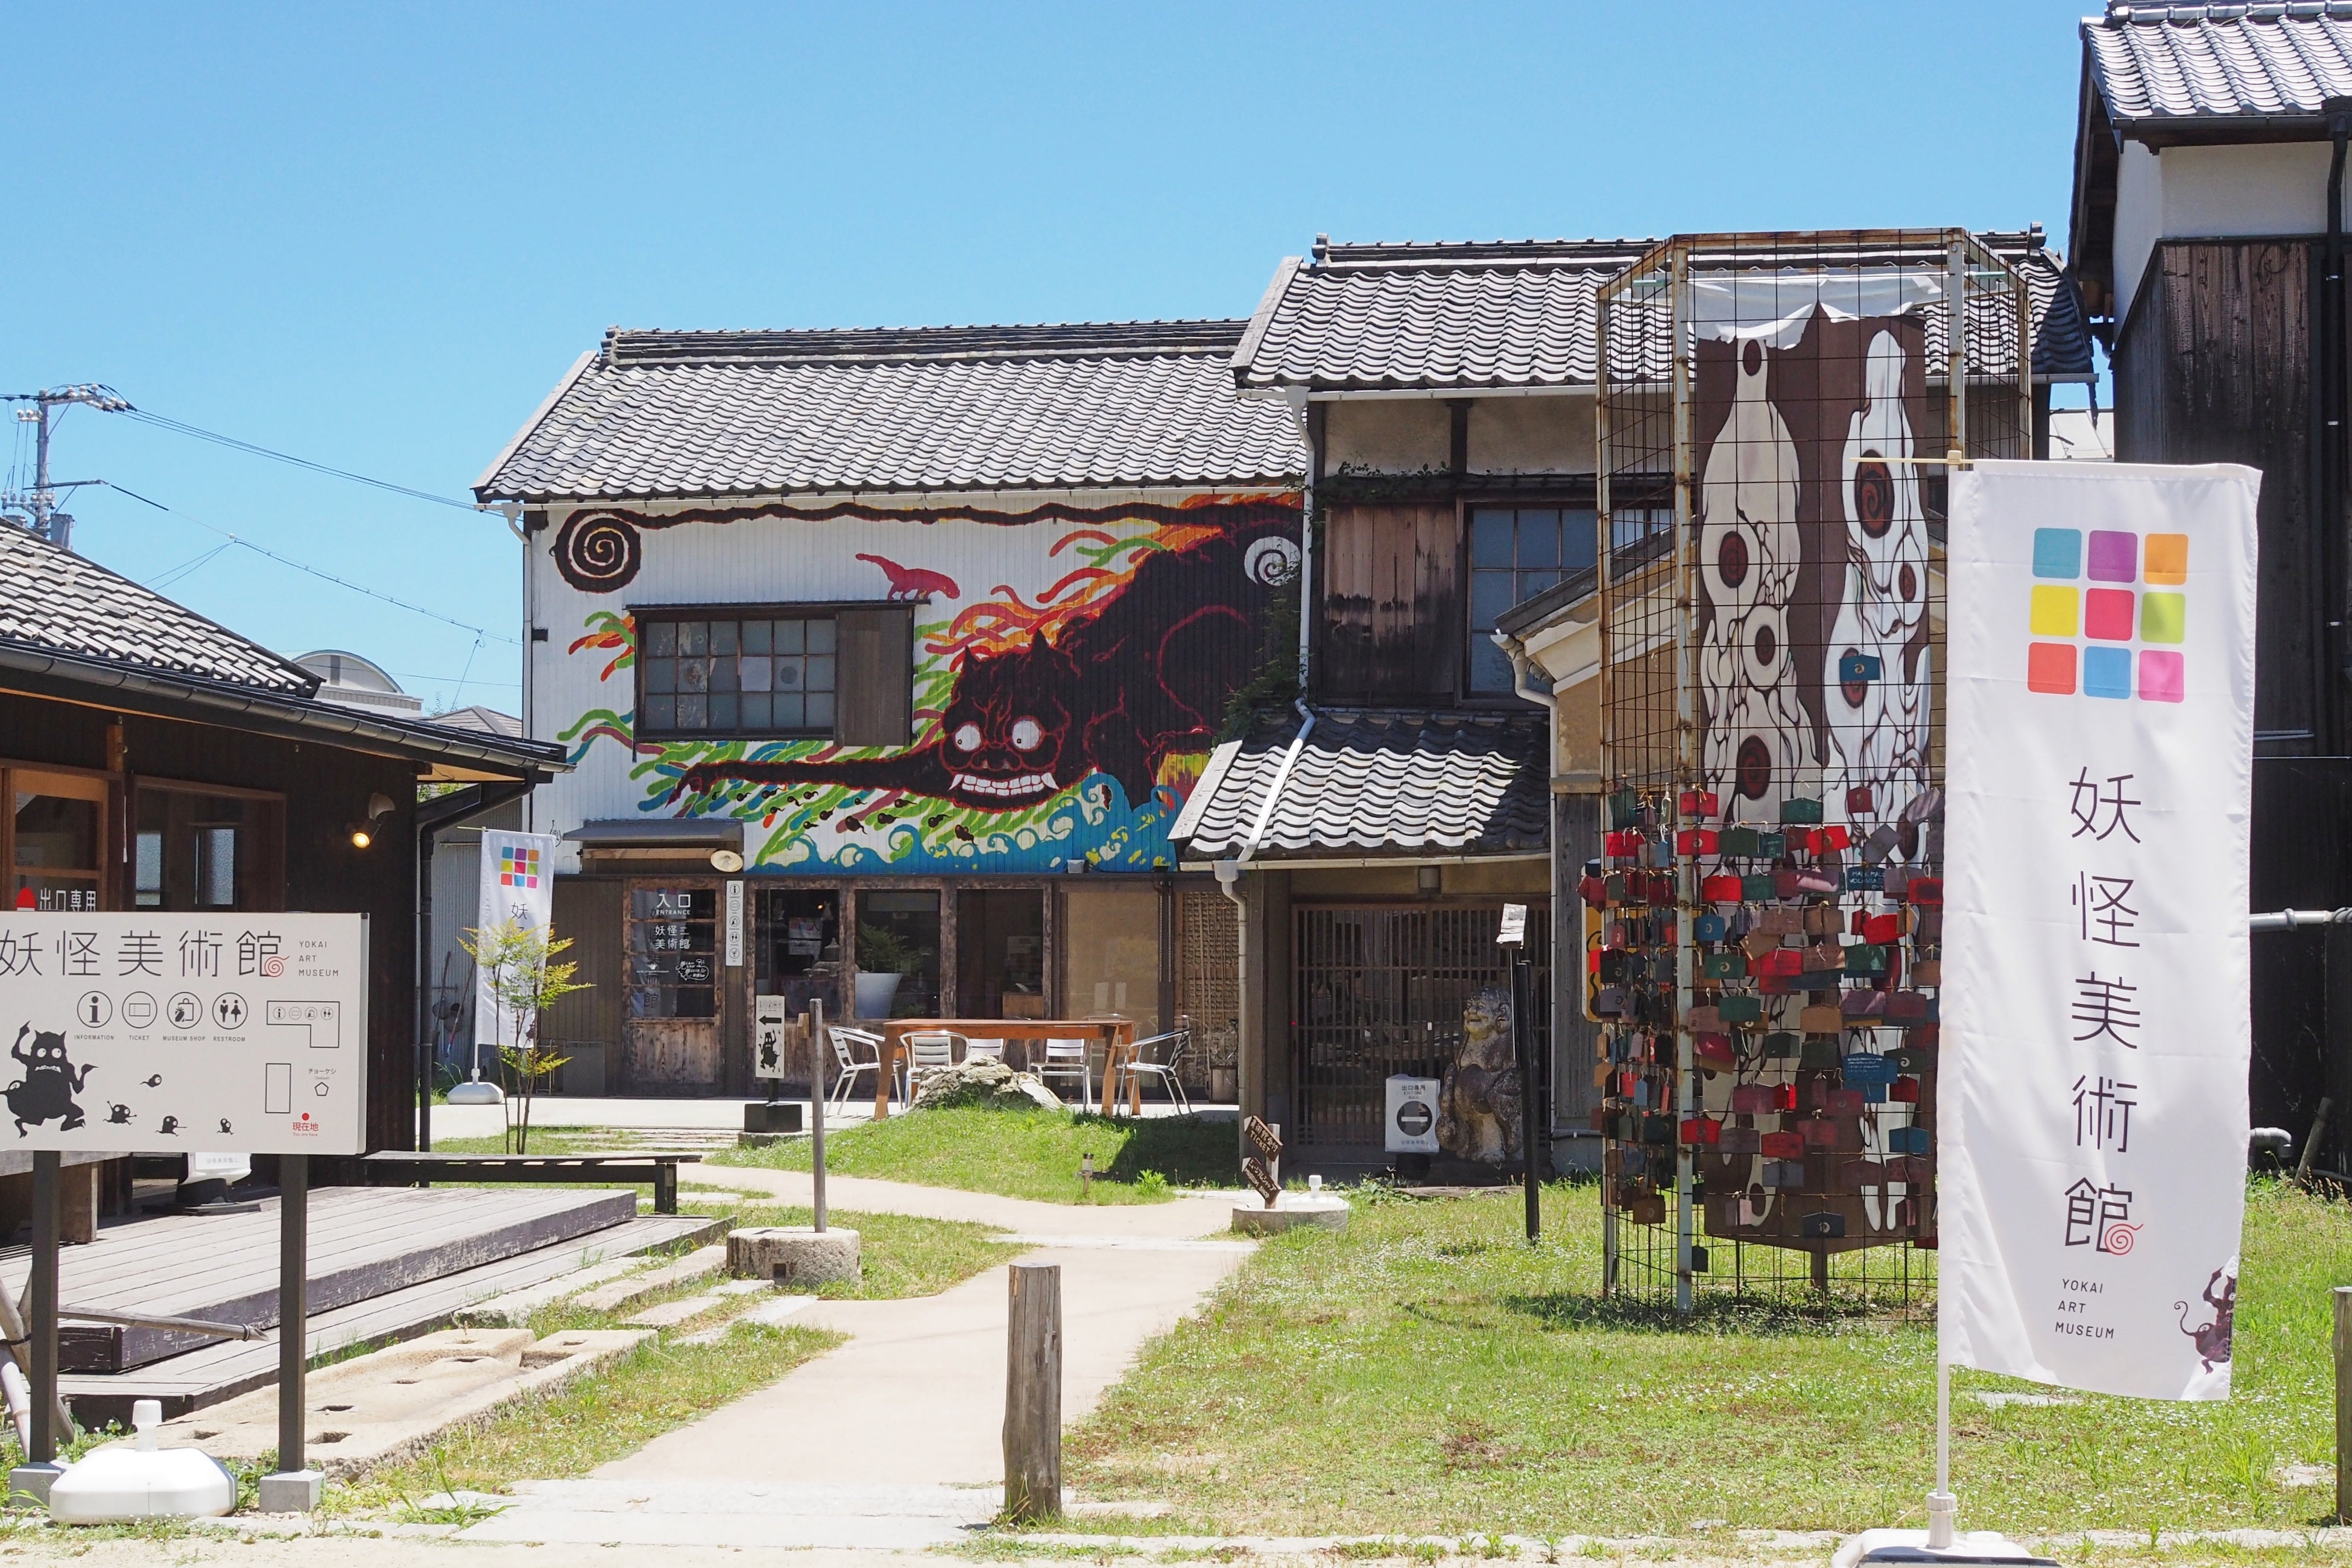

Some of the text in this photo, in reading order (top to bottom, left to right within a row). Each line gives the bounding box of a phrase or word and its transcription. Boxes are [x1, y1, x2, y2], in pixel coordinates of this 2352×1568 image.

[39, 887, 97, 912] 出口専用
[656, 894, 691, 908] 入口
[655, 938, 691, 950] 美術館
[0, 930, 283, 978] 妖怪美術館
[2064, 766, 2143, 1254] 妖怪美術館
[292, 1122, 318, 1131] 現在地
[1250, 1130, 1271, 1154] TICKET
[1244, 1168, 1271, 1200] MUSEUM SHOP
[2062, 1278, 2104, 1294] YOKAI
[2058, 1300, 2086, 1314] ART
[2055, 1321, 2115, 1339] MUSEUM
